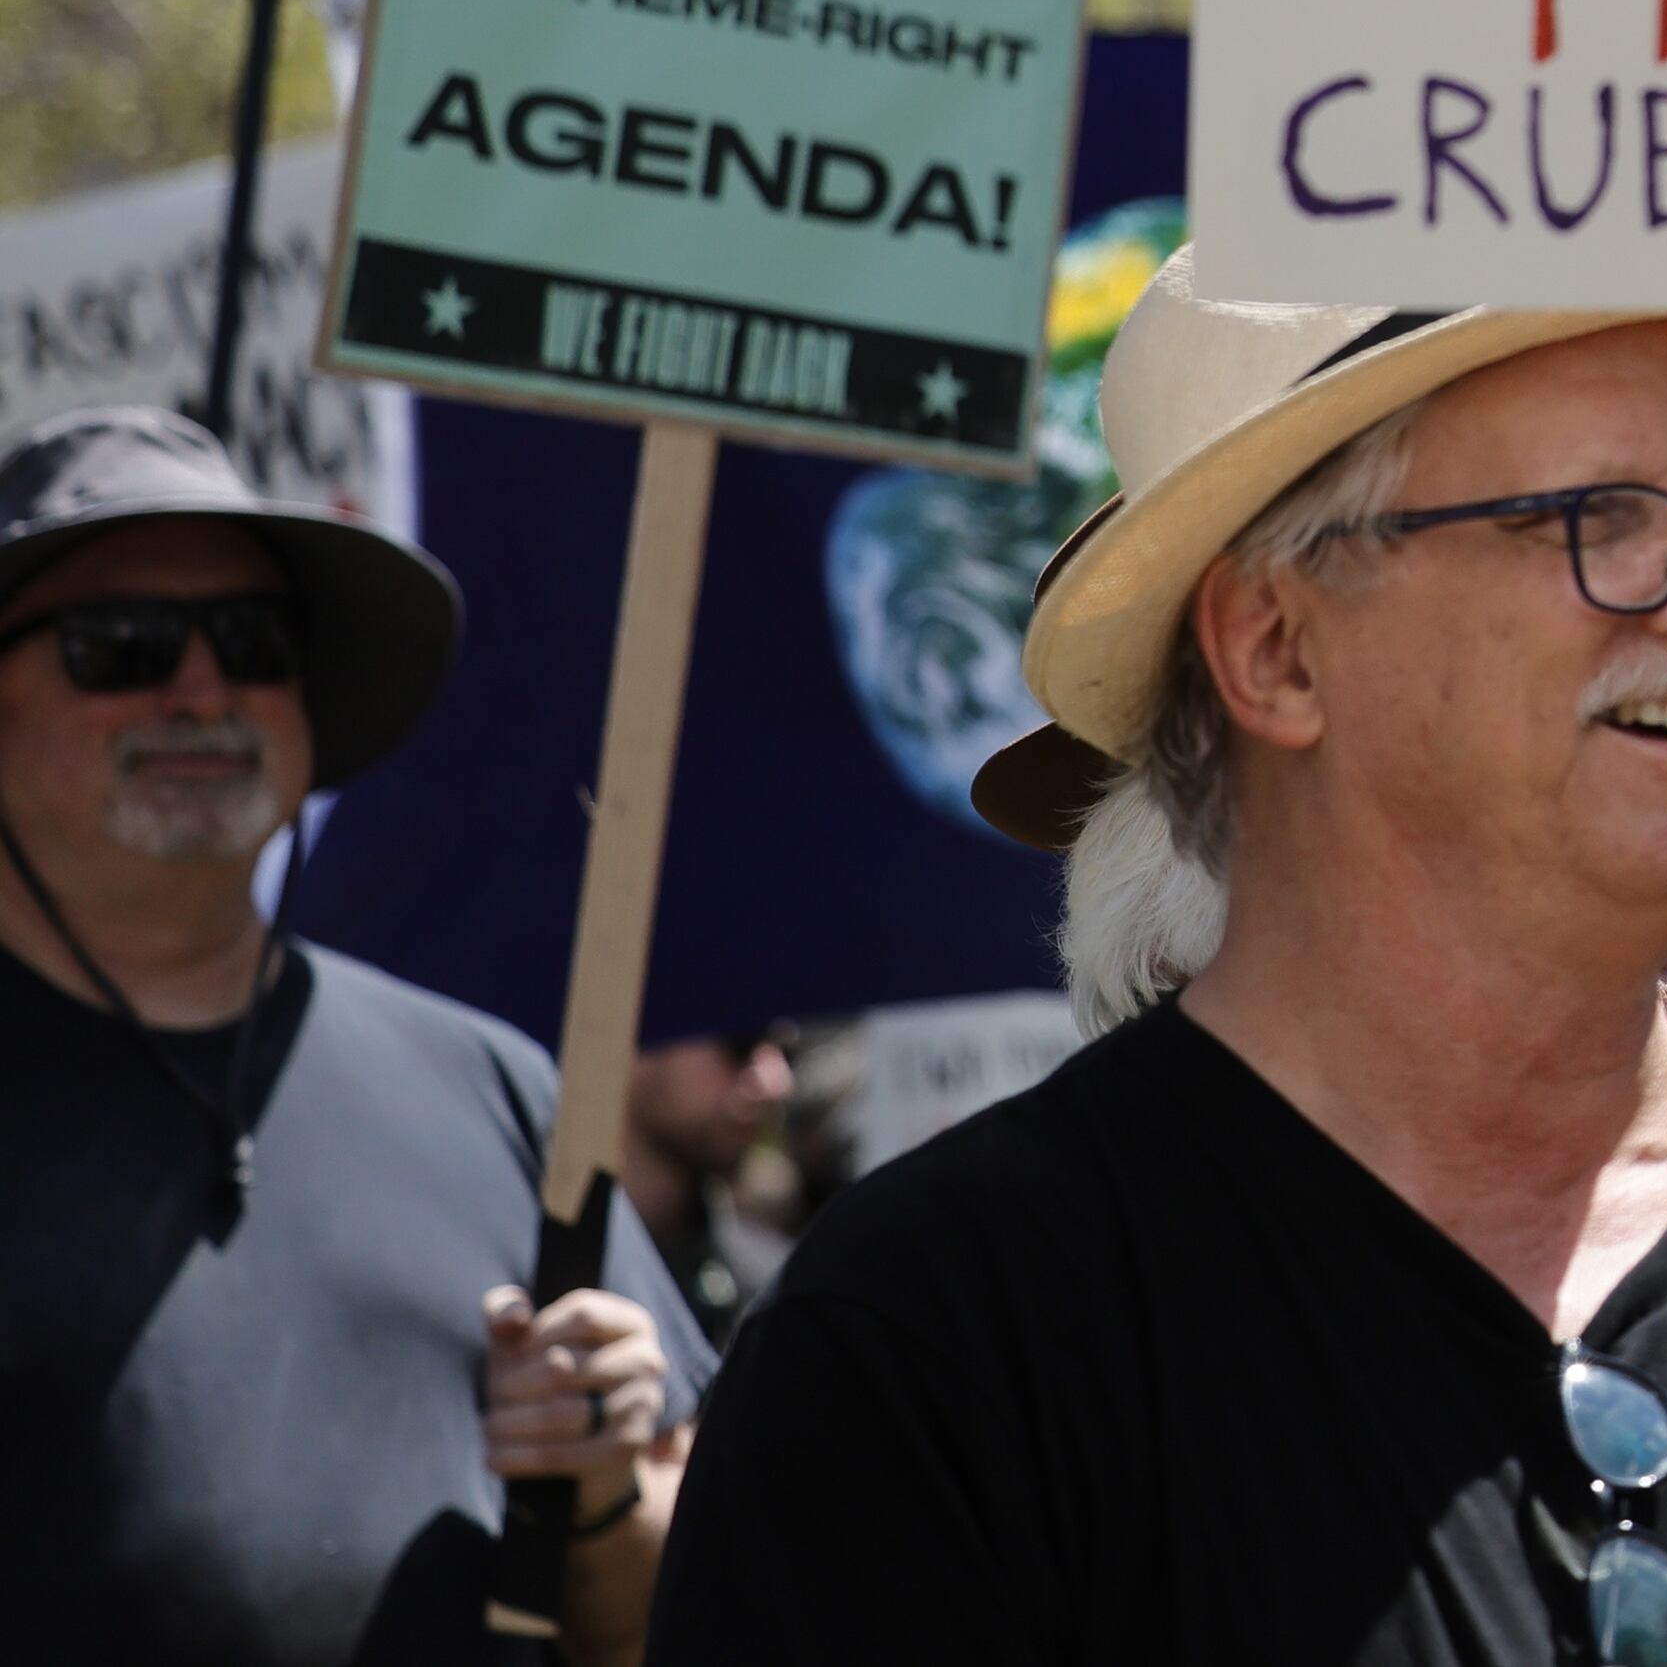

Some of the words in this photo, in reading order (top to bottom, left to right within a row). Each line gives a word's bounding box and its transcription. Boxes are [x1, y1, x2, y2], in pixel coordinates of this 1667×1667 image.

[406, 73, 1019, 253] AGENDA!
[542, 279, 610, 376] WE
[611, 293, 742, 397] FIGHT
